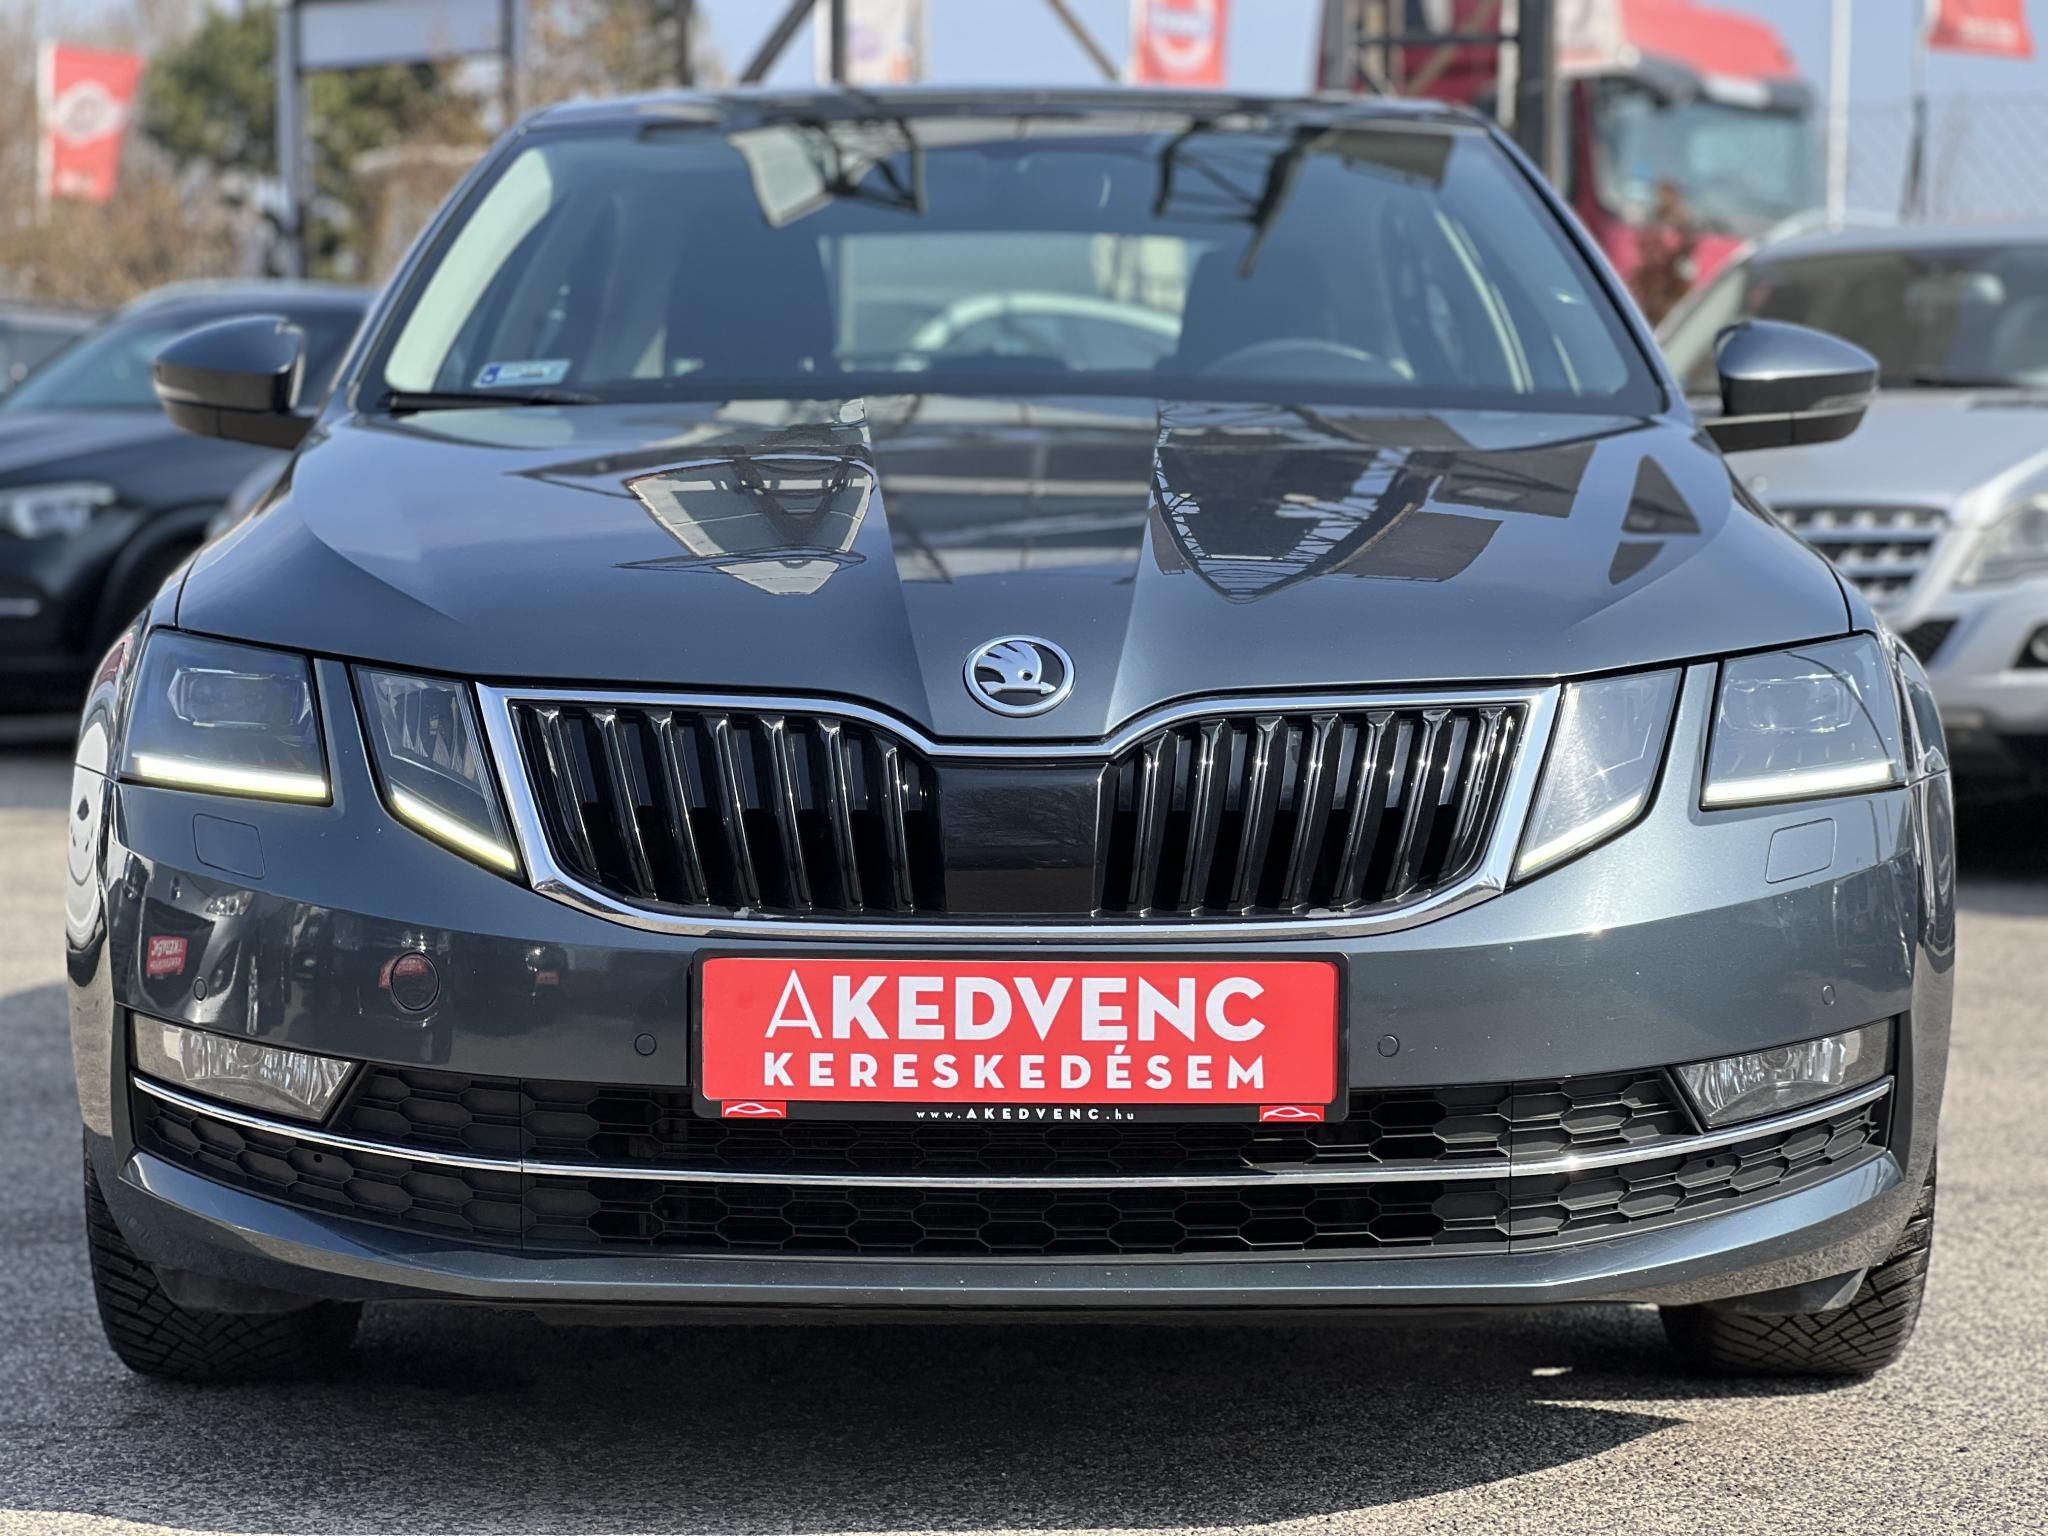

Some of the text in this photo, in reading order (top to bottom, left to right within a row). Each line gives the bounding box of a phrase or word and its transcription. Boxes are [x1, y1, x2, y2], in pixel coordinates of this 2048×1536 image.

[764, 969, 1267, 1042] AKEDVENC
[764, 1044, 1265, 1090] KERESKEDÉSEM
[916, 1107, 1135, 1121] www.AKEDVENC.hu
